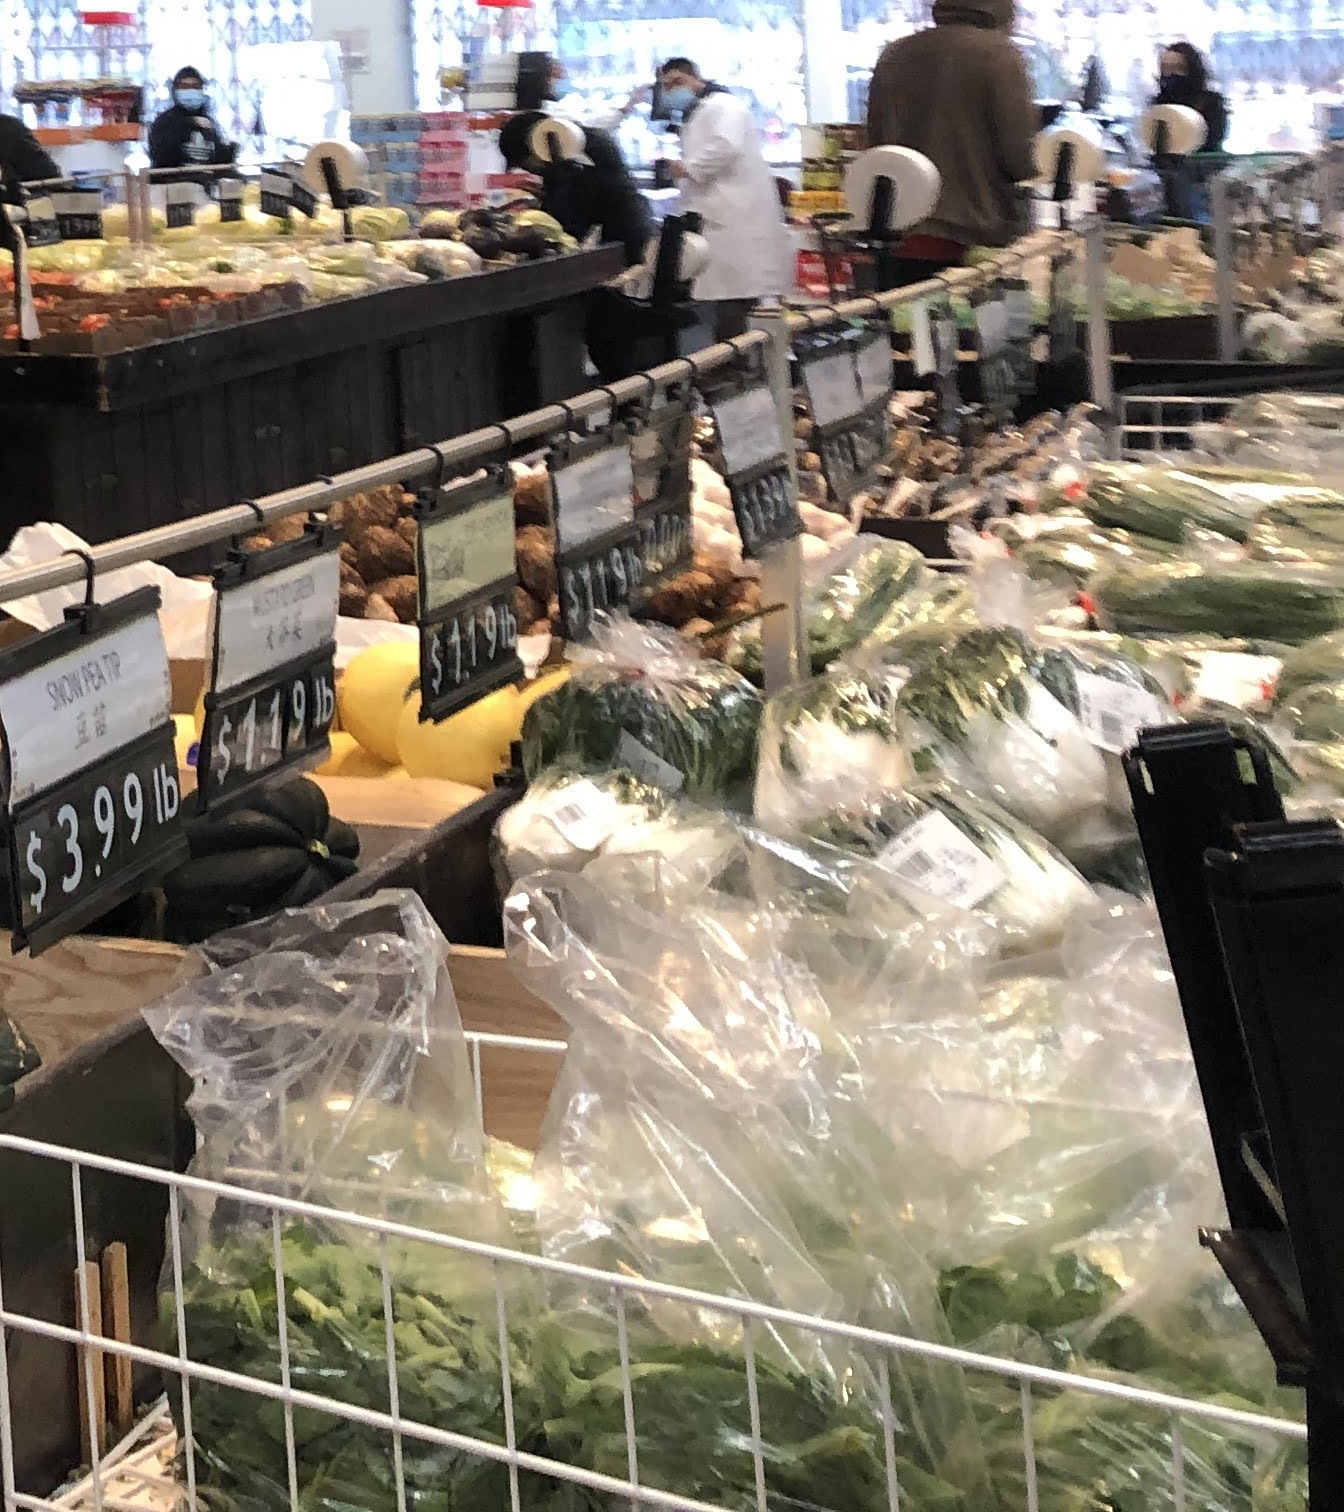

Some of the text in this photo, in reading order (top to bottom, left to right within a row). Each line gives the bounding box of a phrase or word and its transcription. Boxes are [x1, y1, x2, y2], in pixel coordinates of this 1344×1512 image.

[431, 604, 517, 695] $1.19 lb
[217, 675, 334, 786] $1.19 lb
[26, 763, 179, 915] $3.99 lb
